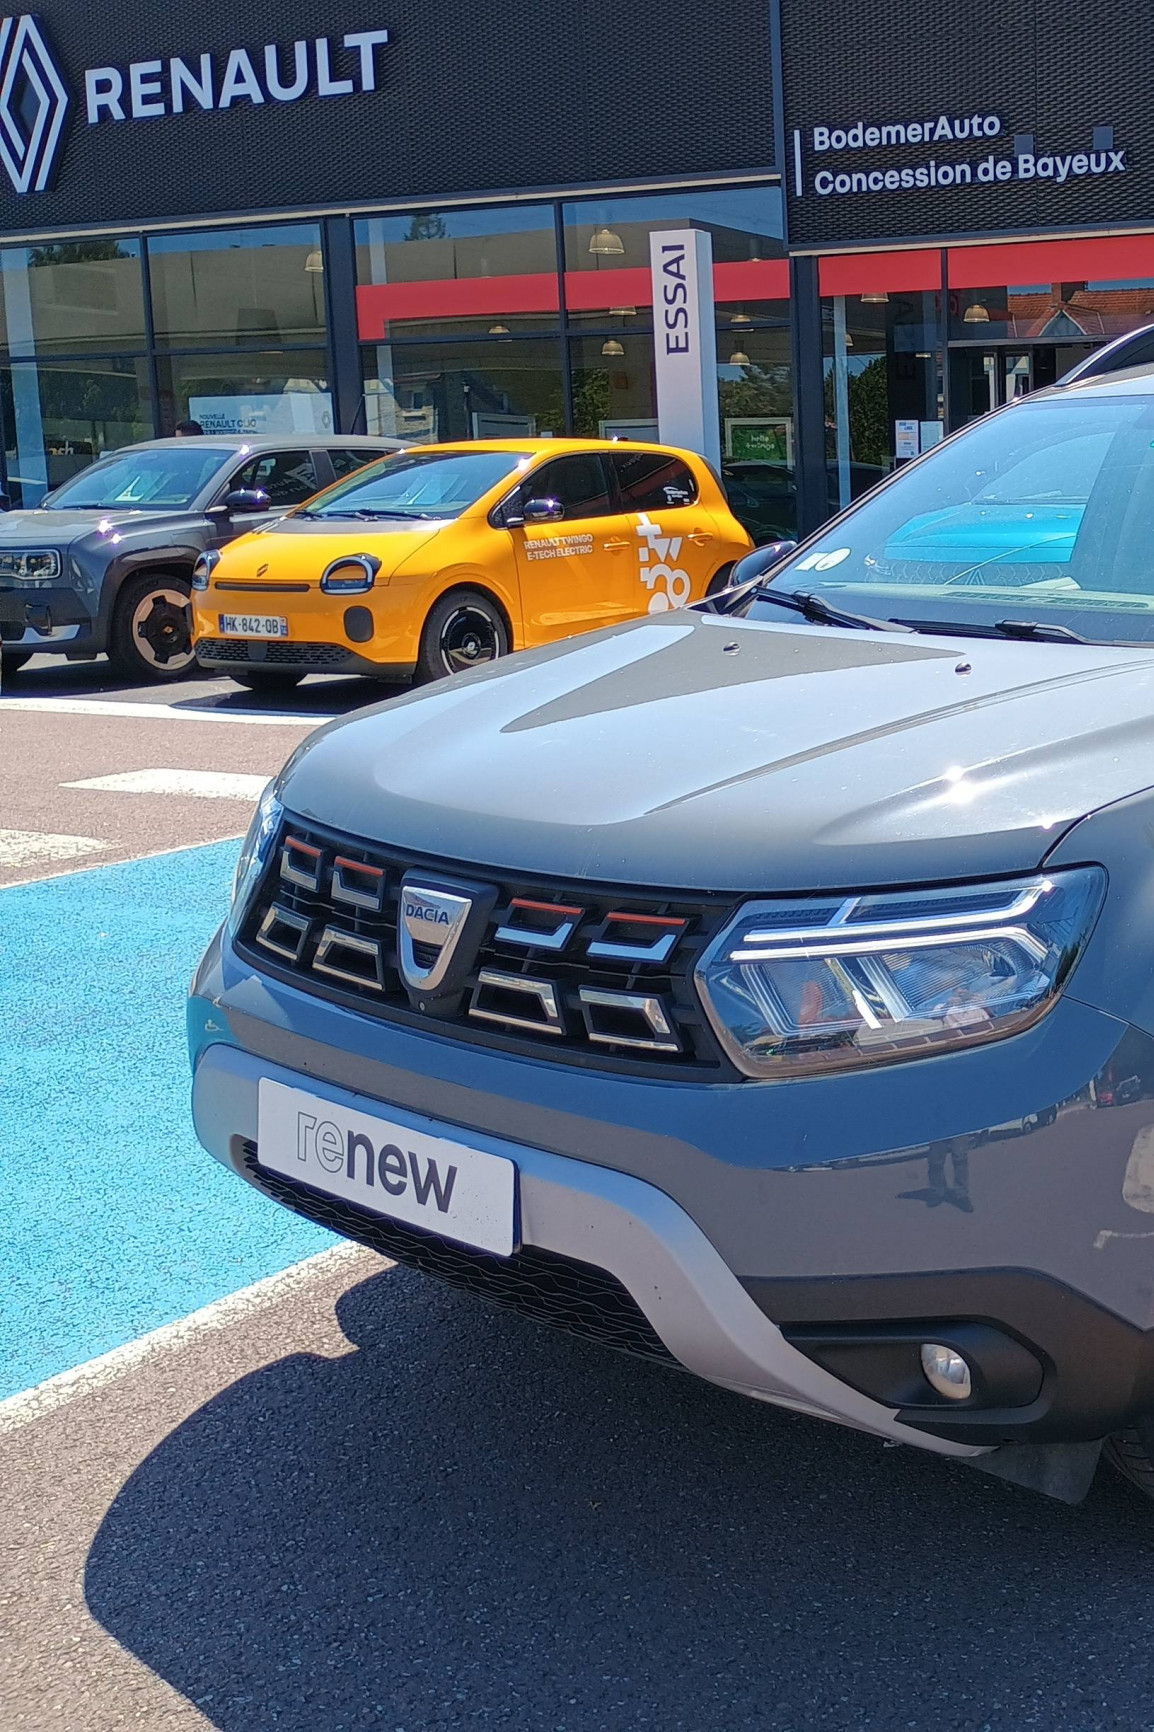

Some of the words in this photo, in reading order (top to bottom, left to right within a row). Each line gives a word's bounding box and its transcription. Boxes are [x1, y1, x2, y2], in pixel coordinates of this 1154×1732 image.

[85, 30, 388, 124] RENAULT
[813, 114, 1001, 151] BodemerAuto
[814, 160, 971, 195] Concession
[977, 156, 1012, 182] de
[1018, 150, 1126, 183] Bayeux
[661, 244, 689, 355] ESSAI
[524, 537, 560, 549] RENAULT
[560, 534, 593, 544] TWINGO
[527, 549, 556, 561] E-TECH
[556, 545, 593, 557] ELECTRIC
[405, 903, 450, 926] DACIA
[297, 1111, 458, 1214] renew
